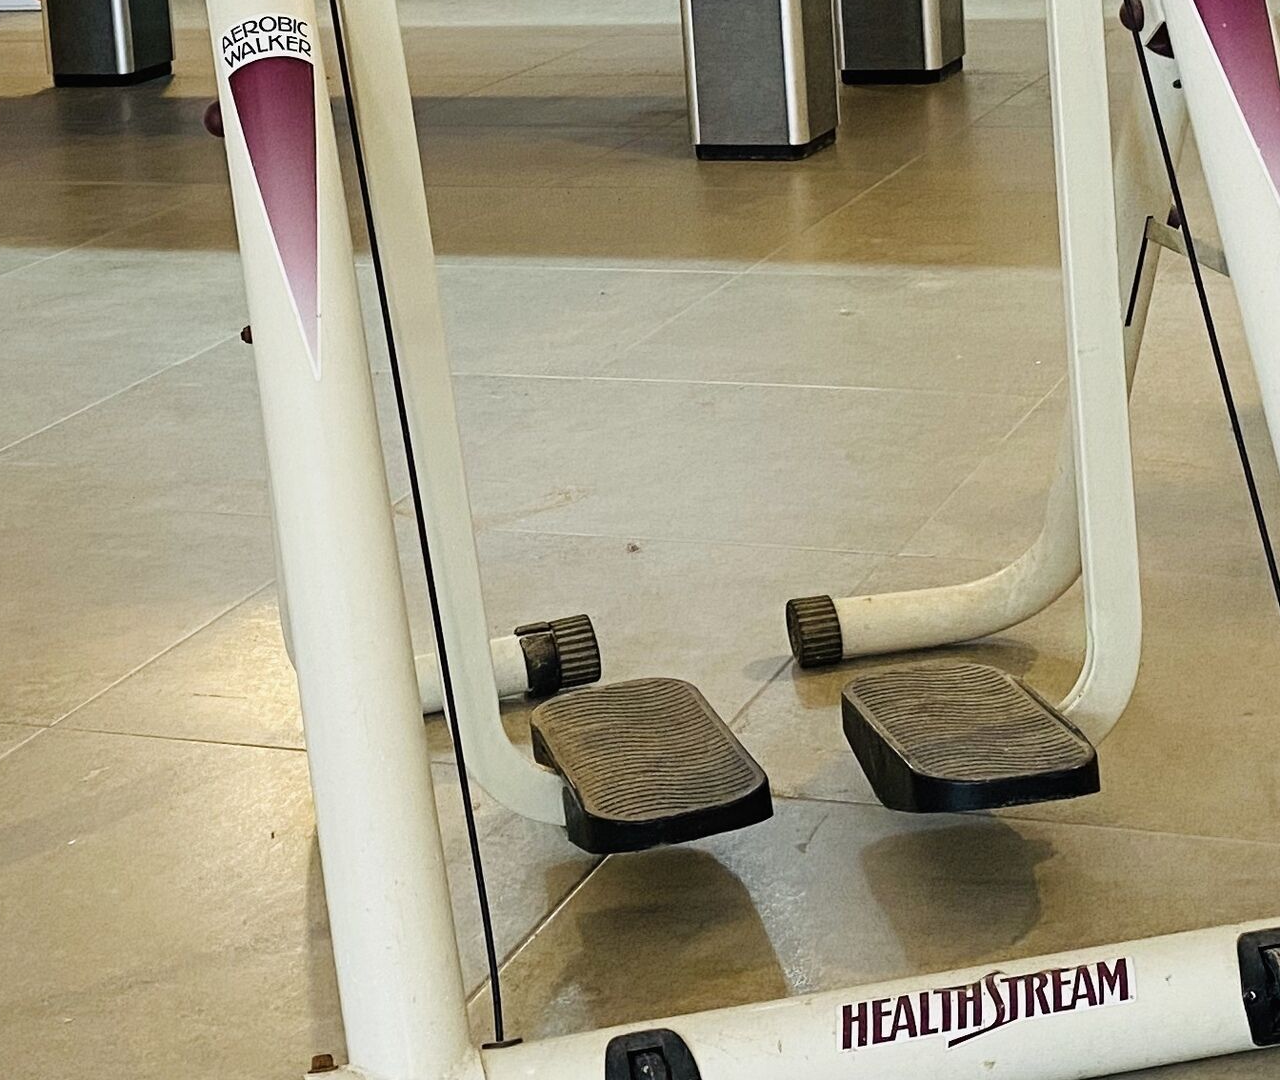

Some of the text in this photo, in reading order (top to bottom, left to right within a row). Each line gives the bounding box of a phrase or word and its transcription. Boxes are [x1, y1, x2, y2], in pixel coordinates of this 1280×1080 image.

[222, 15, 308, 54] AEROBIC
[224, 34, 312, 68] WALKER
[841, 957, 1131, 1049] HEALTHSTREAM
